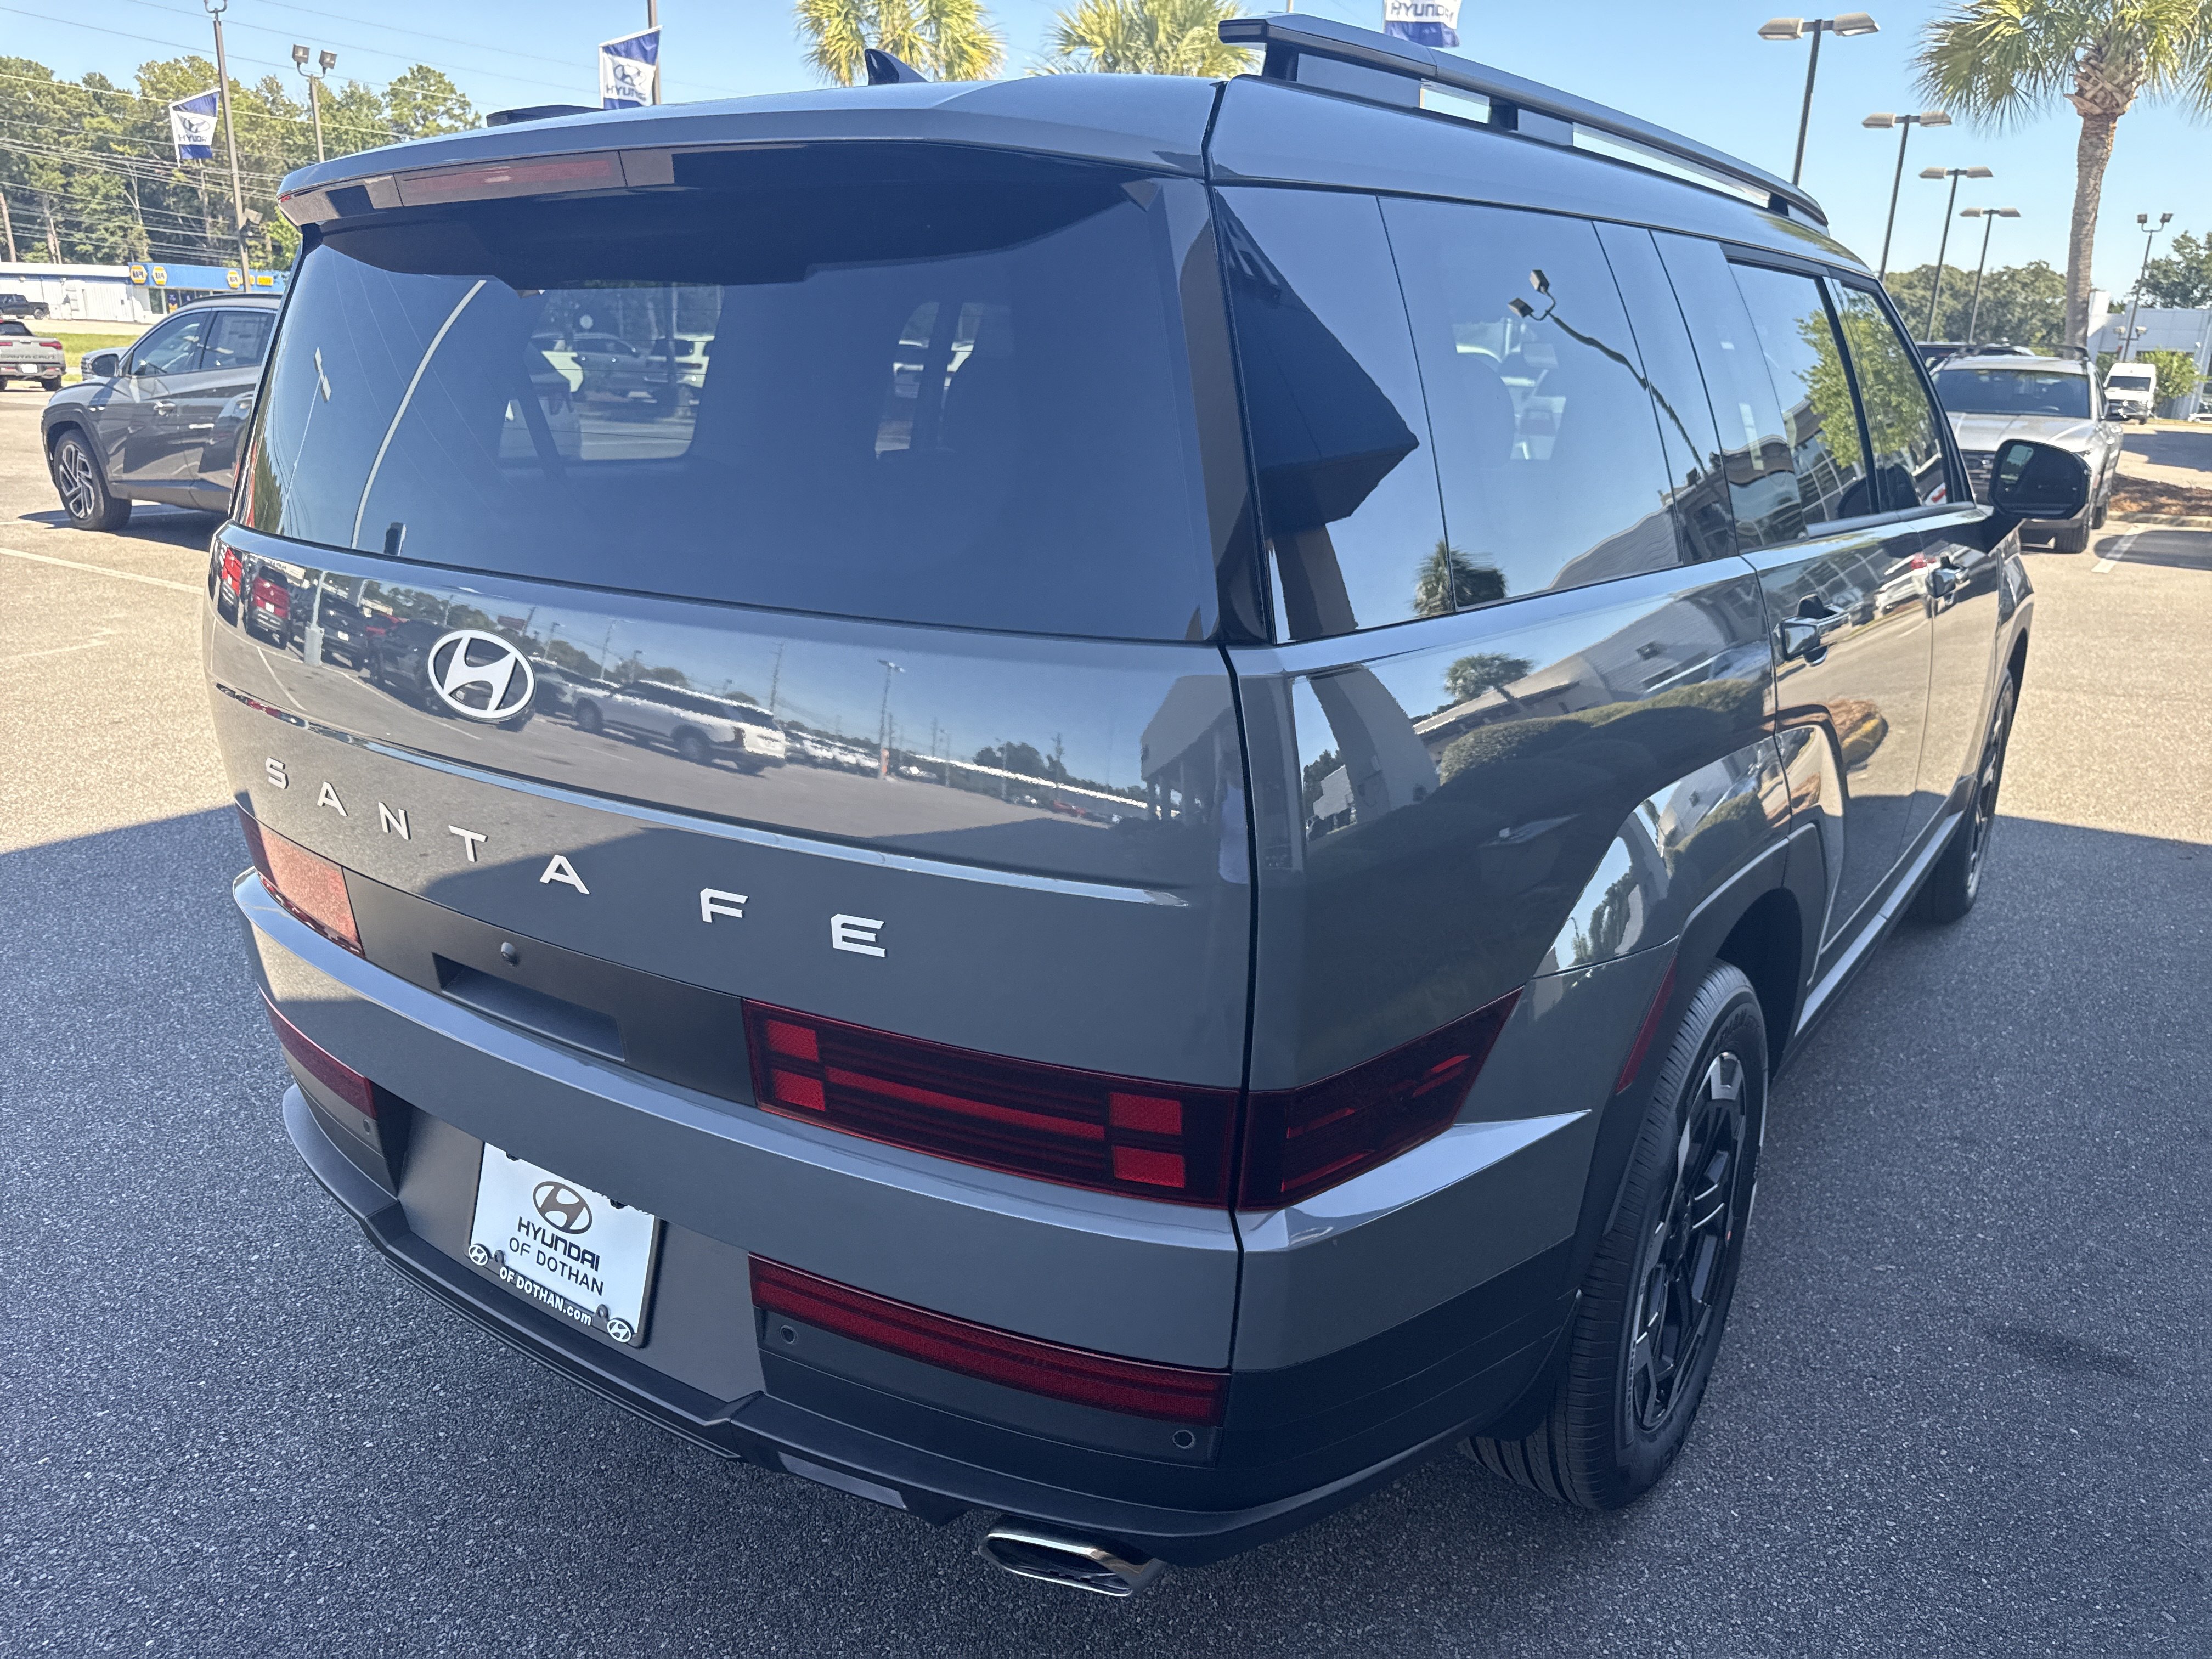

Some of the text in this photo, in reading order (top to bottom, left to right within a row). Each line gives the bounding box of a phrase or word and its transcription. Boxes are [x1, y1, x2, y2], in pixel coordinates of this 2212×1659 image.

[265, 757, 887, 958] SANTA FE
[509, 1237, 604, 1296] OF DOTHAN
[517, 1216, 600, 1272] HYUNDAI
[499, 1267, 592, 1327] OF DOTHAN.com
